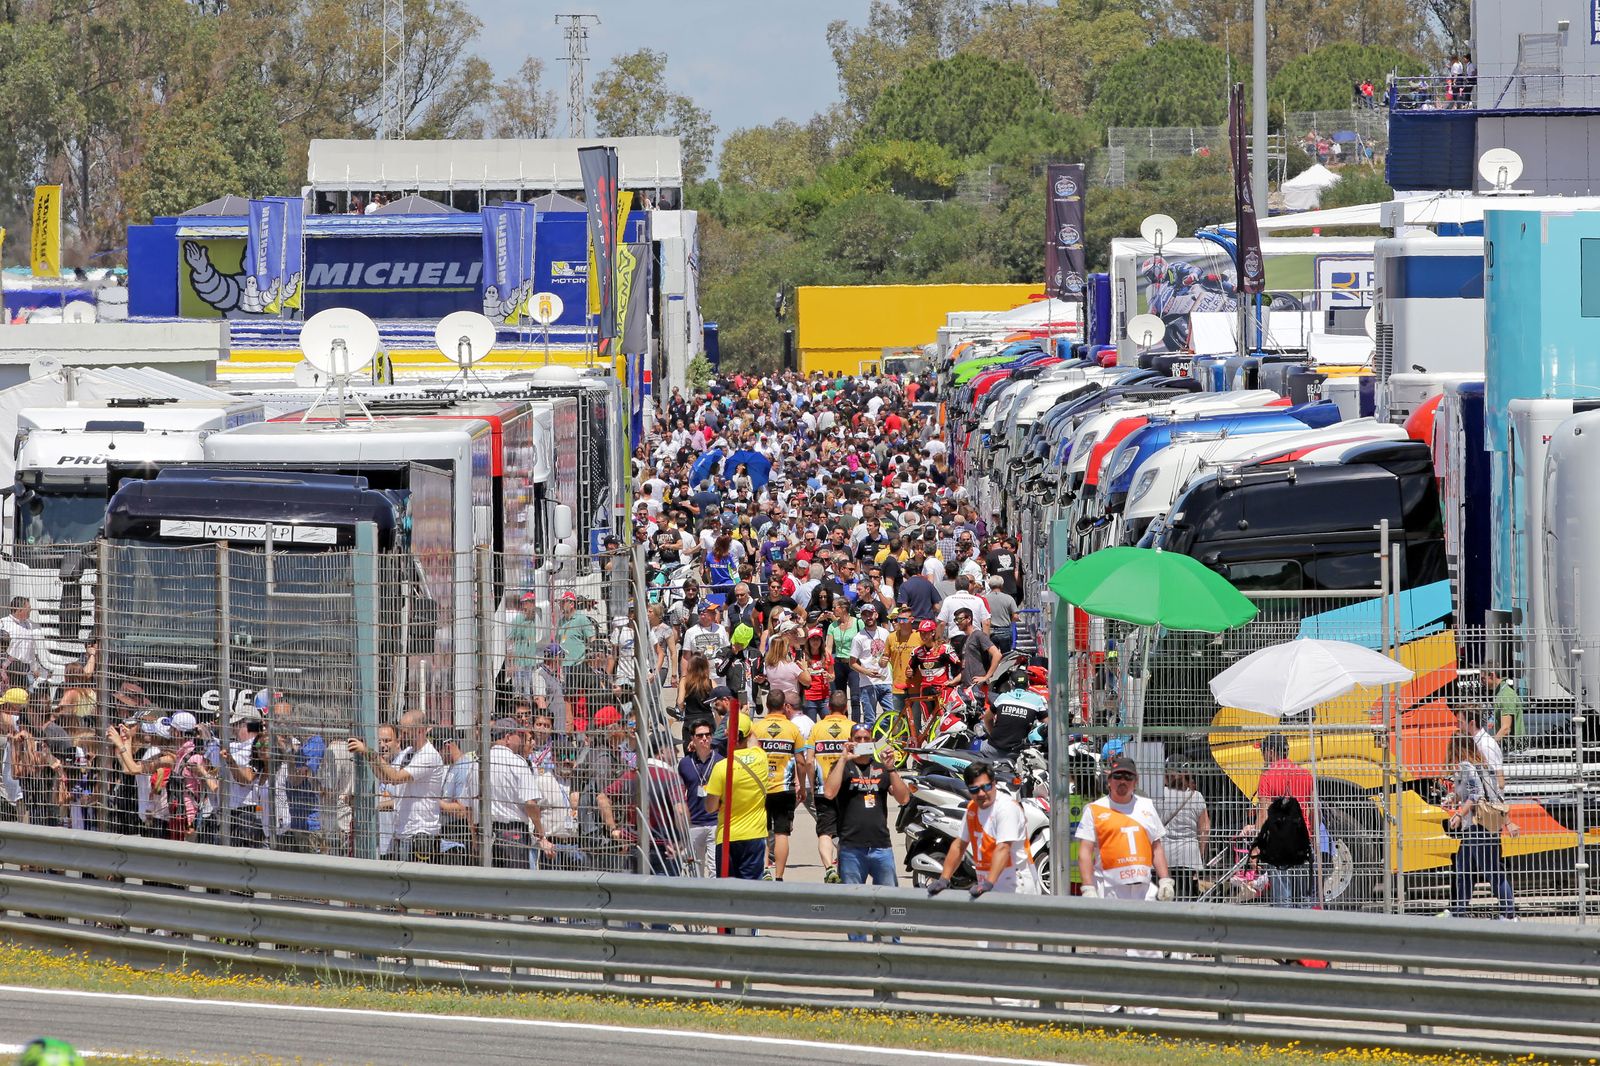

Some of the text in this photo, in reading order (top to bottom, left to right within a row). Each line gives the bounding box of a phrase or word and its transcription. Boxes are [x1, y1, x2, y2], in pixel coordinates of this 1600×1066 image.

[259, 205, 271, 276] MICHELIN
[498, 213, 507, 284] MICHELIN
[307, 262, 483, 286] MICHELI
[1002, 706, 1028, 716] LEOPARD
[1121, 825, 1140, 855] T
